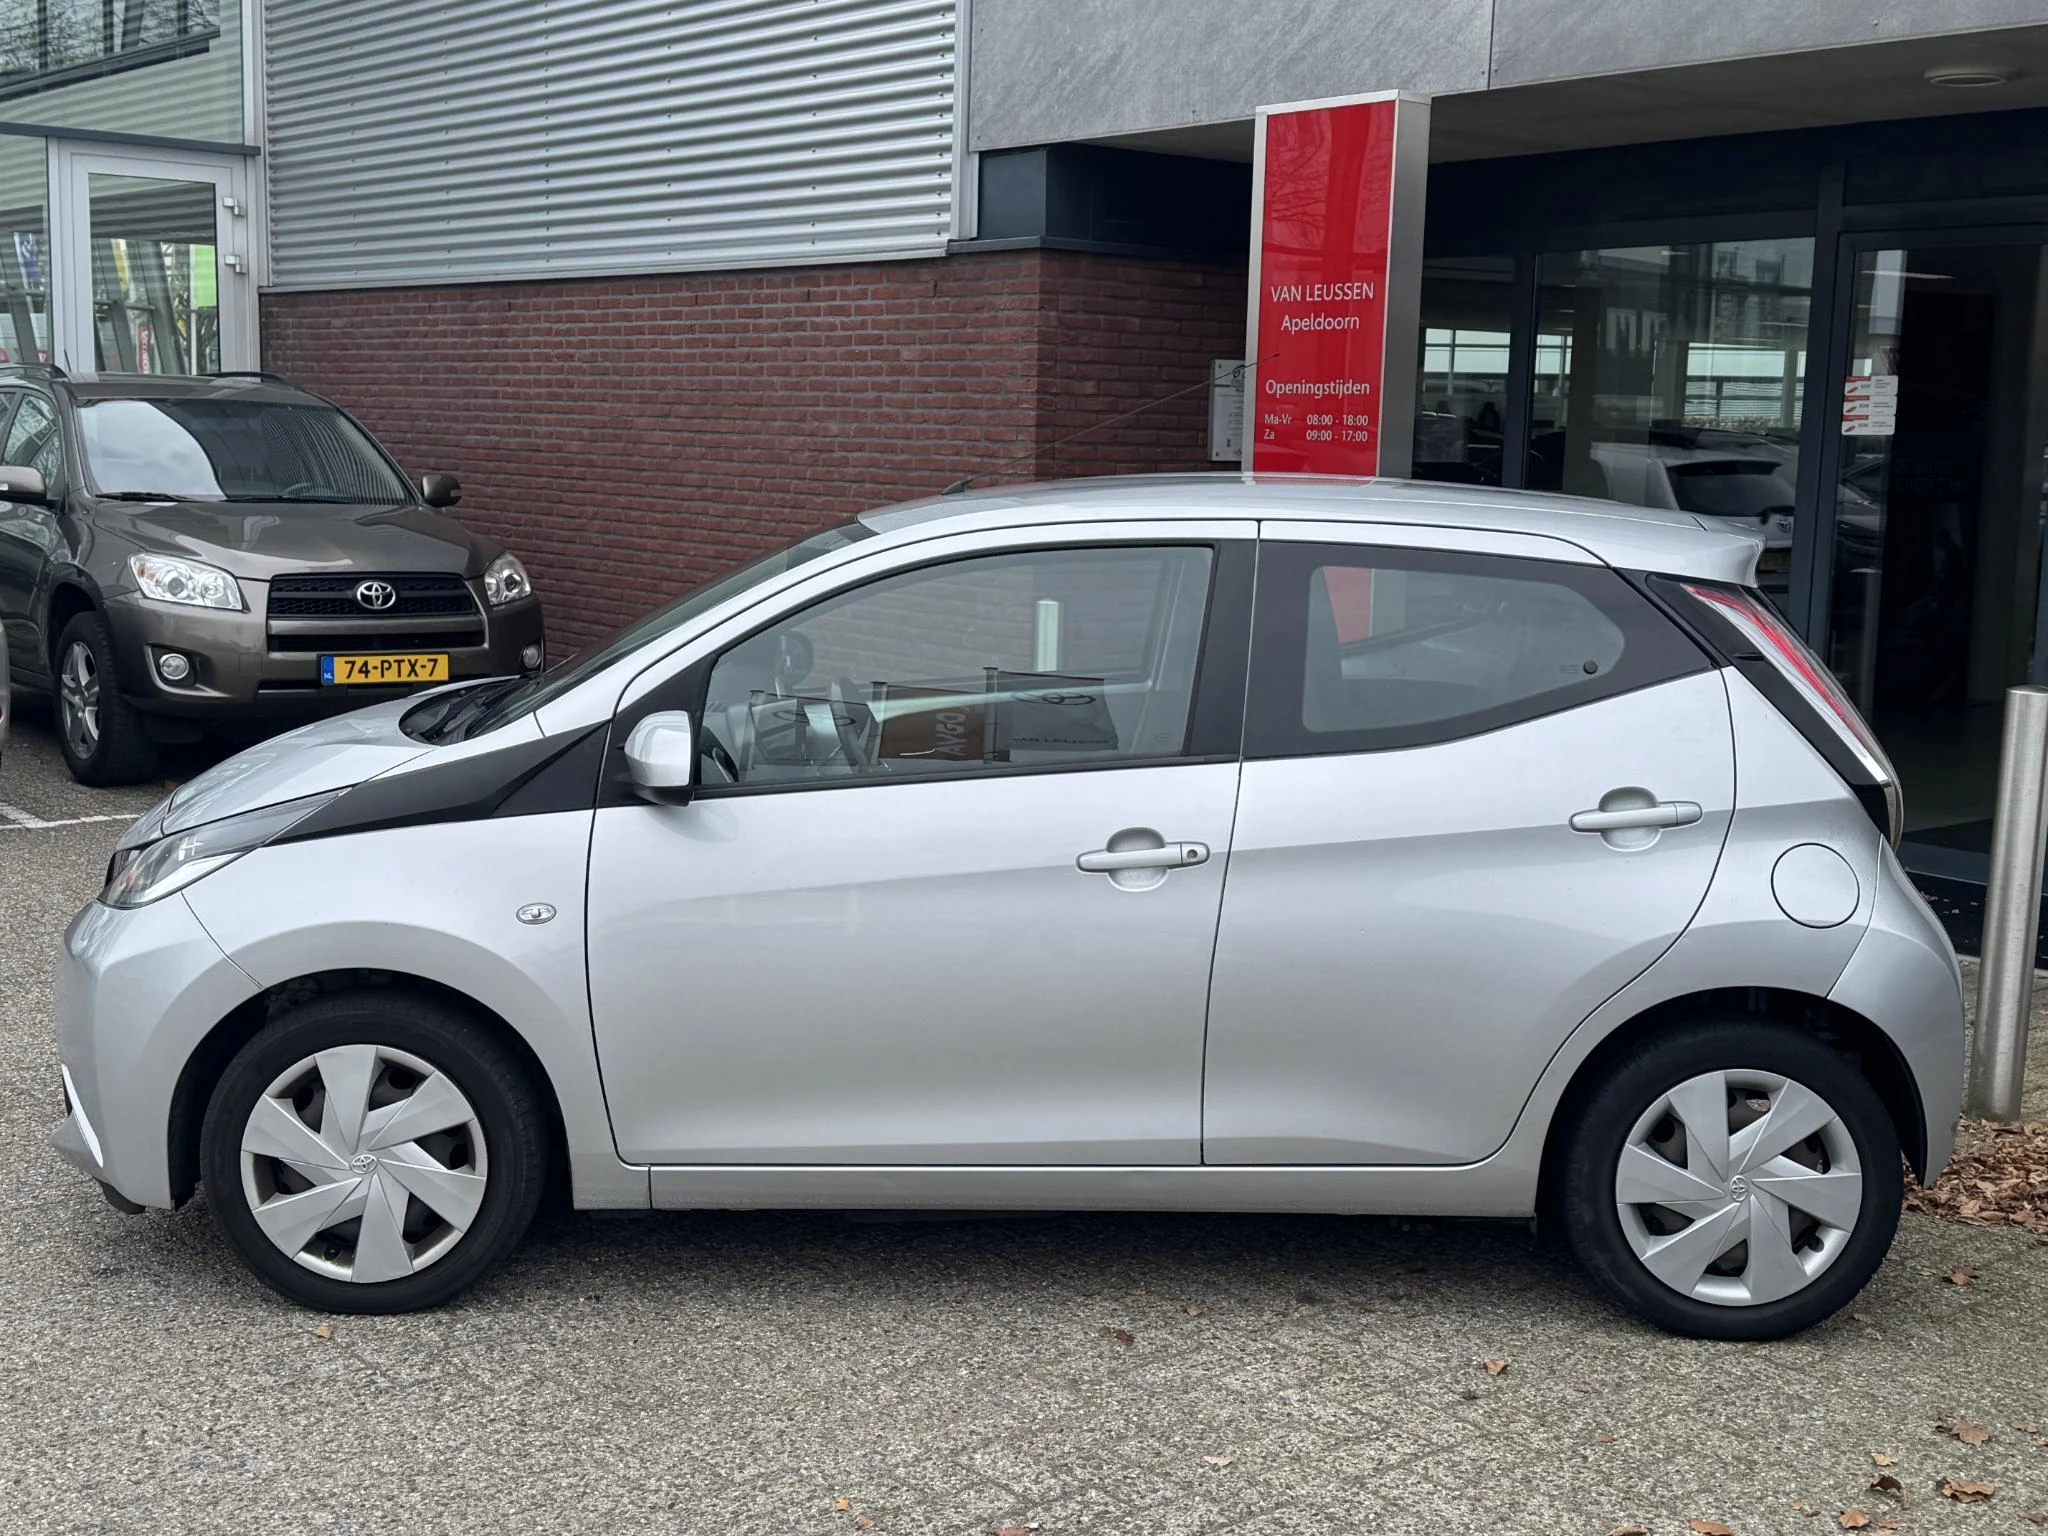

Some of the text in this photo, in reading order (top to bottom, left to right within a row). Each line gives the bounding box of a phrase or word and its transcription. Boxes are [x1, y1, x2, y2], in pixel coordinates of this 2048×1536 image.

[1271, 282, 1374, 302] VAN LEUSSEN
[1281, 313, 1360, 335] Apeldoorn
[1265, 379, 1371, 399] Openingstijden
[1264, 413, 1293, 425] Ma-Vr
[1306, 414, 1333, 426] 08:00
[1342, 415, 1369, 426] 18:00
[1263, 429, 1275, 440] Za
[1306, 430, 1332, 441] 09:00
[1342, 430, 1368, 442] 17:00
[344, 658, 439, 679] 74-PTX-7
[935, 711, 967, 756] AYGO
